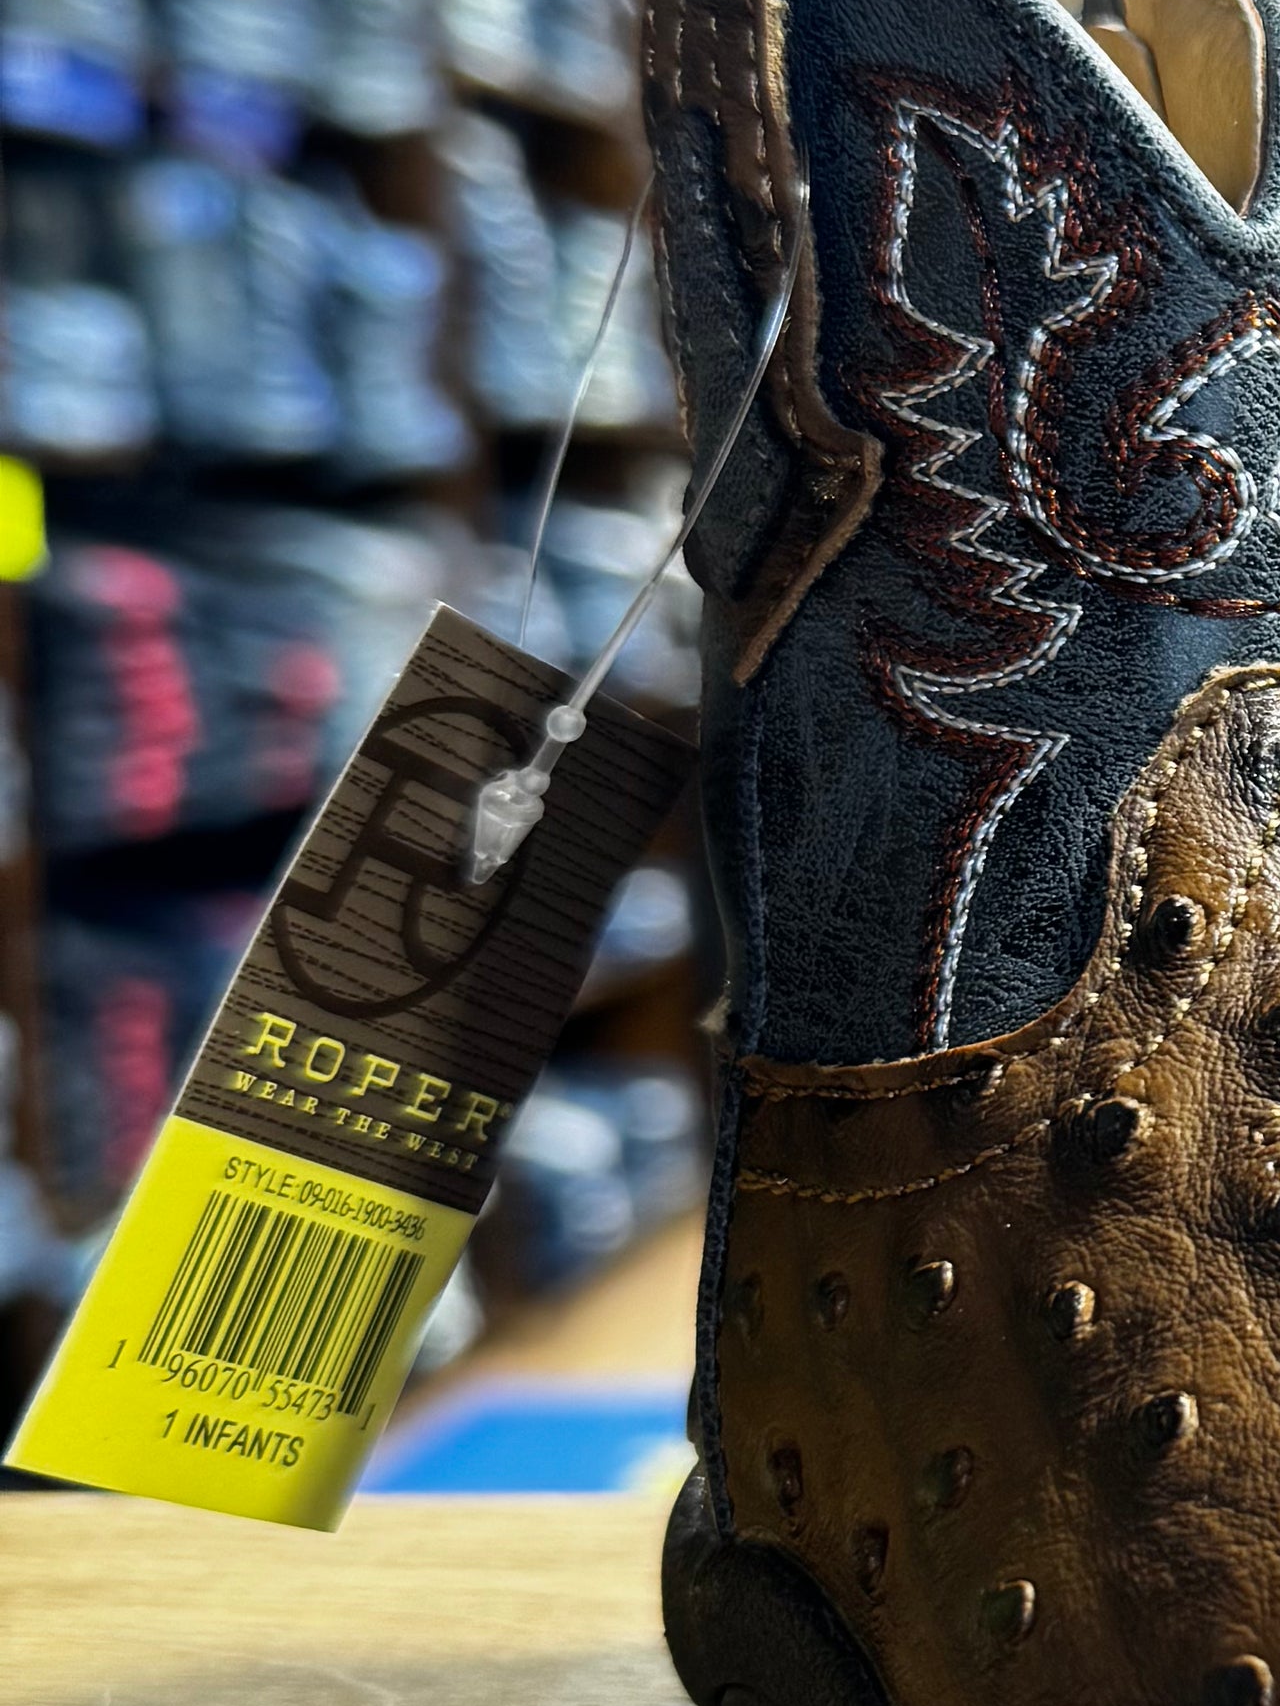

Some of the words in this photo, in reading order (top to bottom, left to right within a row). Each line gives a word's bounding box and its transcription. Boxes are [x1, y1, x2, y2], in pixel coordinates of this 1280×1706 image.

[235, 1070, 320, 1116] WEAR
[336, 1107, 392, 1140] THE
[406, 1132, 479, 1171] WEST
[246, 1012, 499, 1141] ROPER
[107, 1339, 128, 1369] 1
[162, 1353, 251, 1400] 96070
[261, 1379, 337, 1421] 55473
[360, 1403, 377, 1431] 1
[162, 1408, 180, 1439] 1
[183, 1412, 305, 1467] INFANTS
